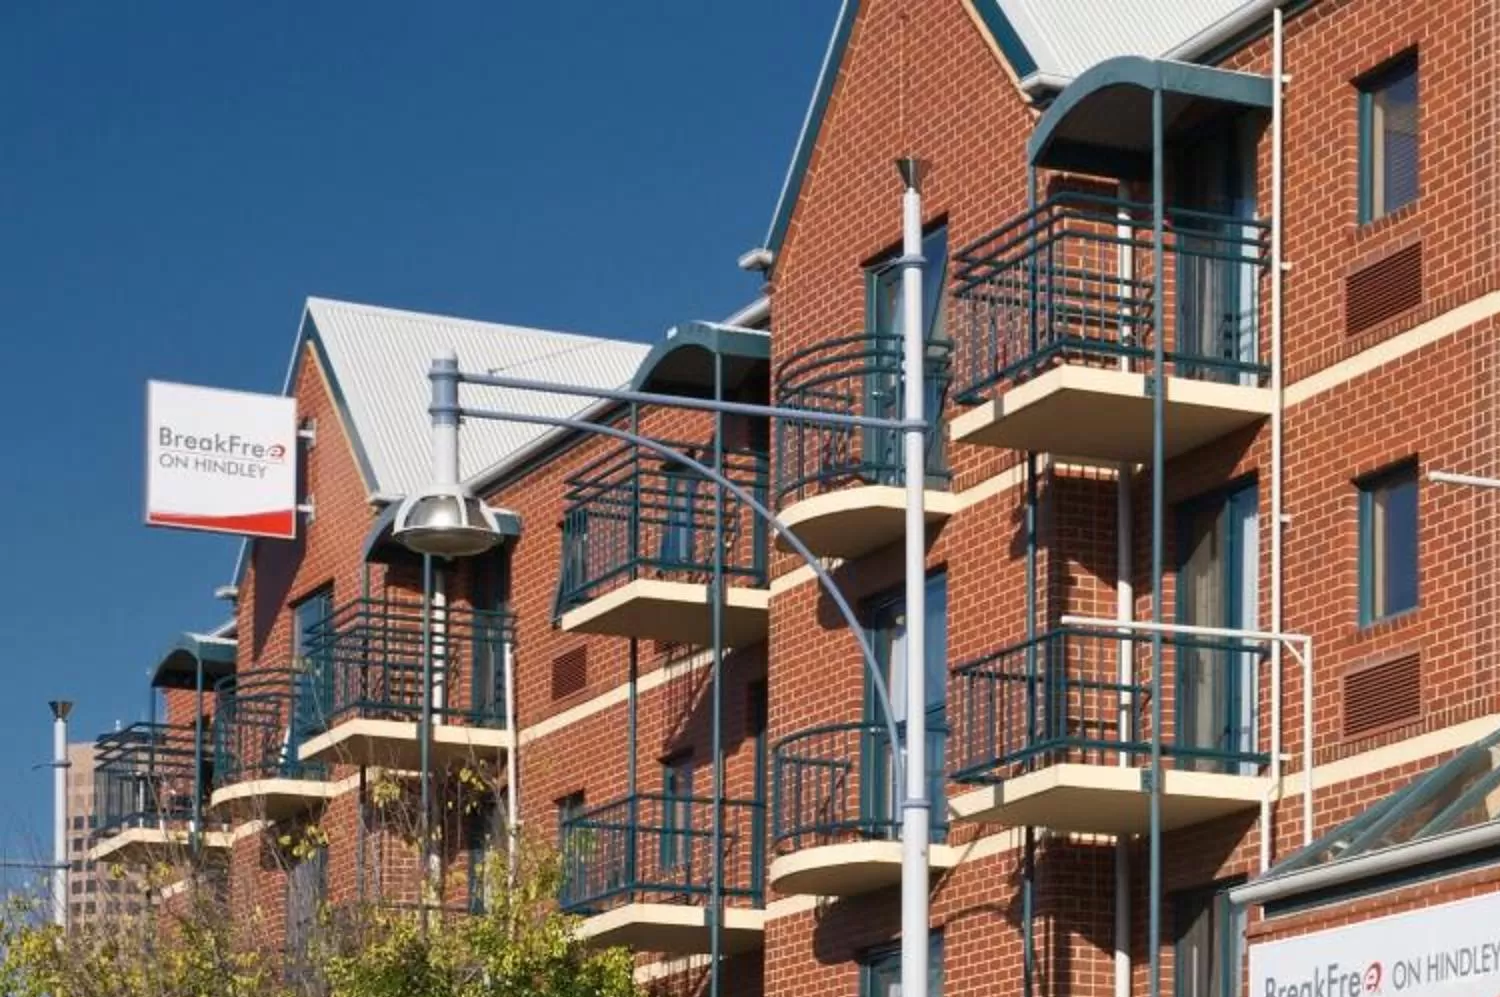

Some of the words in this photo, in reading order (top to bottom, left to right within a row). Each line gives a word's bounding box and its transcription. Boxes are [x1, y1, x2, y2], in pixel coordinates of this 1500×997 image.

[159, 426, 285, 458] BreakFree
[159, 453, 189, 469] ON
[195, 459, 267, 479] HINDLEY
[1392, 957, 1421, 991] ON
